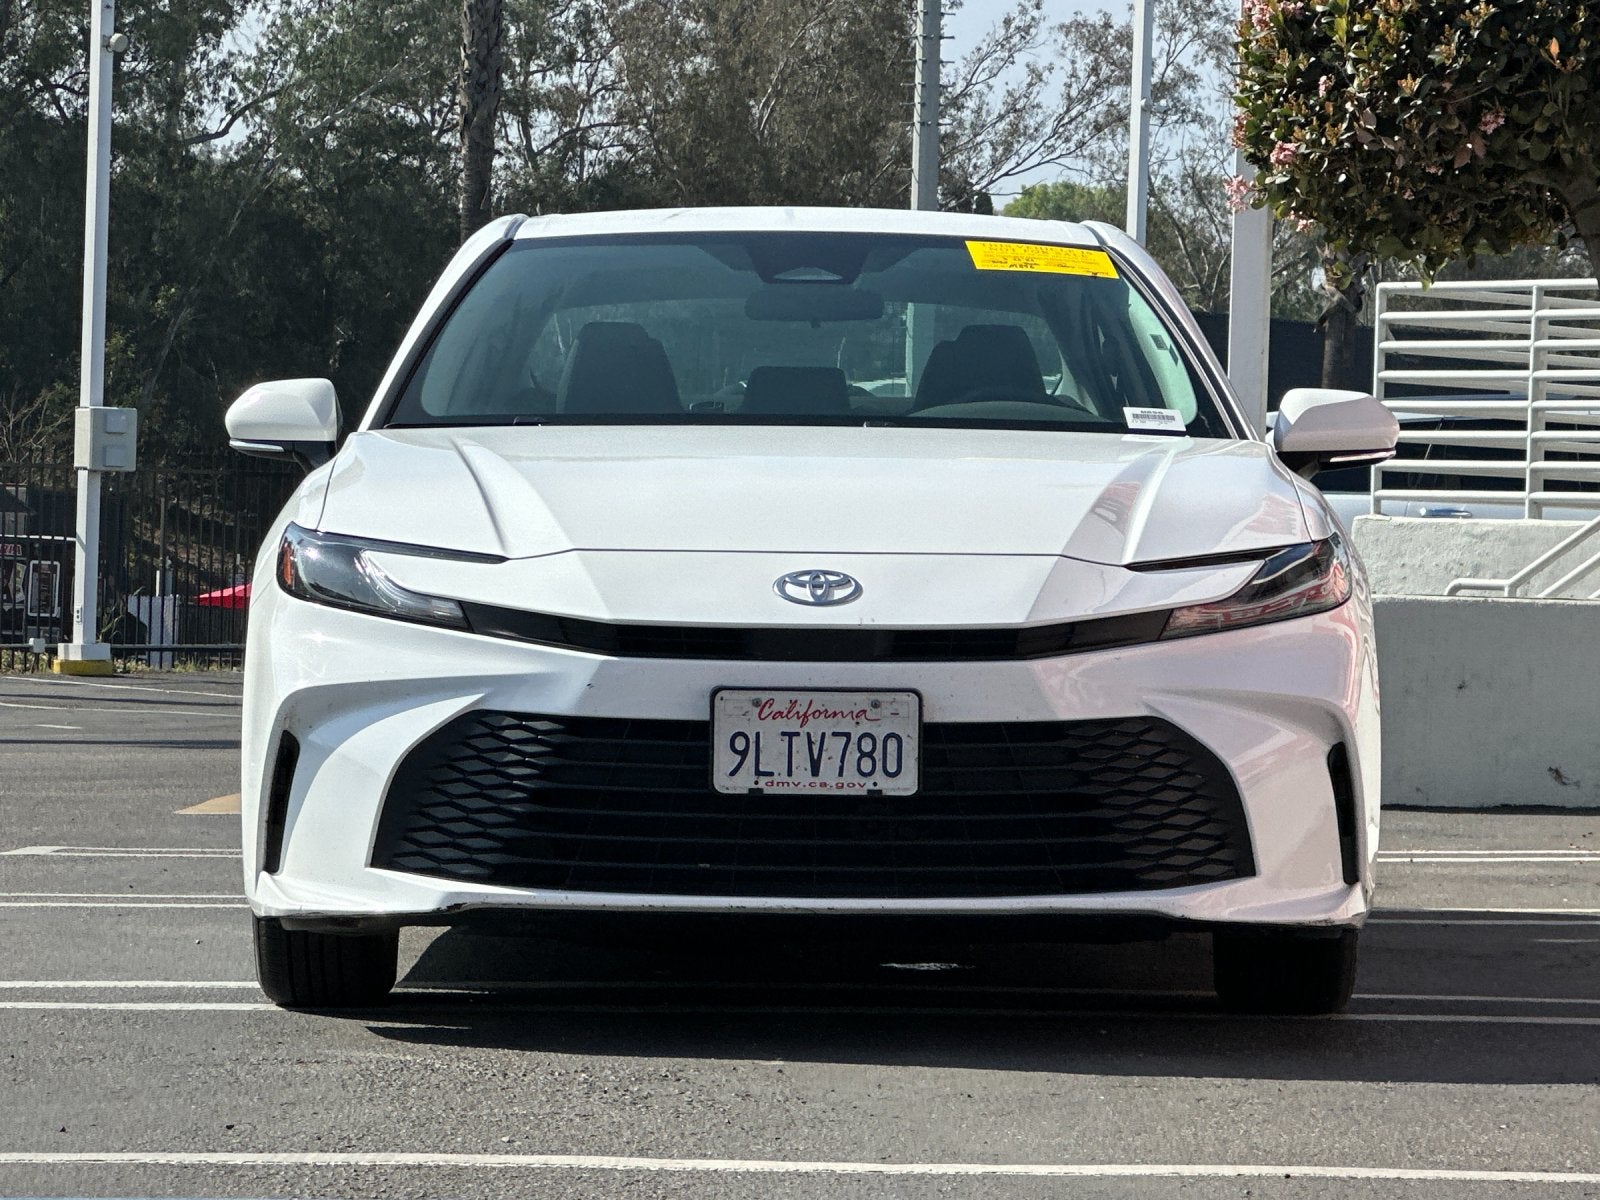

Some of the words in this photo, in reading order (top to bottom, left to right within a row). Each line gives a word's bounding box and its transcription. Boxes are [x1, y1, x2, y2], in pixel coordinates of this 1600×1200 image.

[757, 697, 881, 728] California
[728, 731, 904, 778] 9LTV780
[764, 780, 867, 789] dmv.ca.gov
